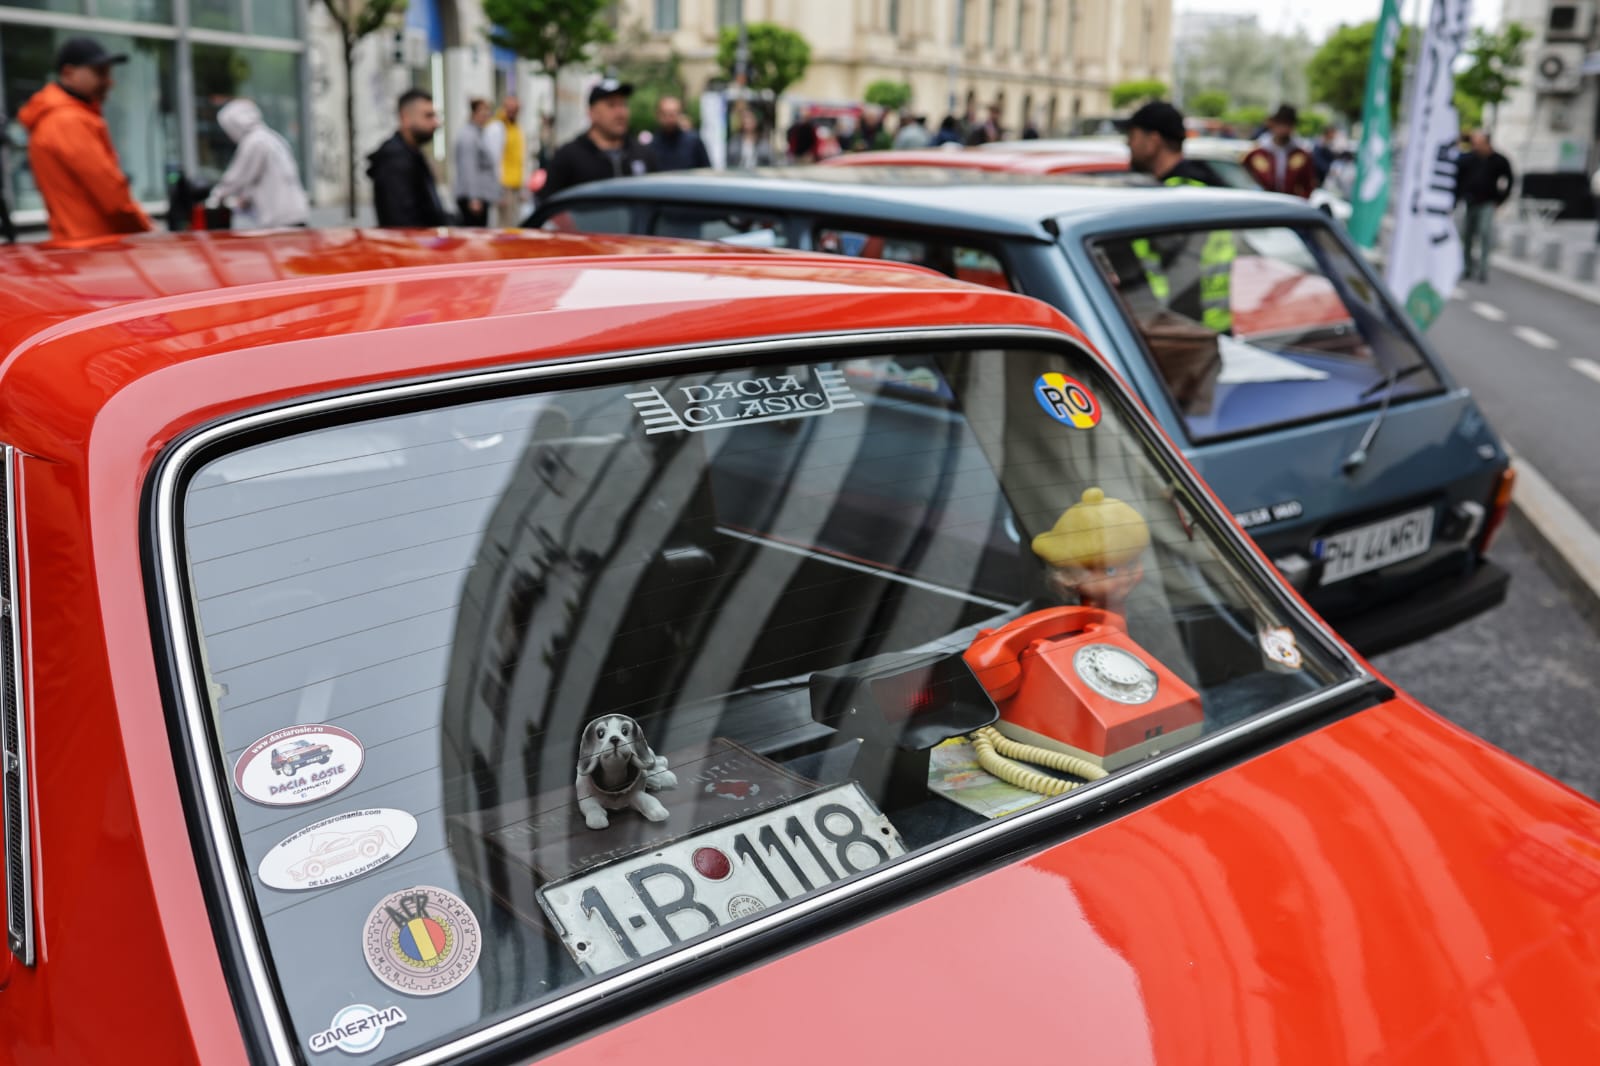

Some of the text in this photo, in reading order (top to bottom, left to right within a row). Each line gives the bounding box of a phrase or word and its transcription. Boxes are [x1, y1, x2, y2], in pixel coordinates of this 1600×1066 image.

[680, 375, 804, 404] DACIA
[1041, 385, 1092, 416] RO
[684, 393, 826, 424] CLASIC
[269, 764, 346, 795] DACIA ROSIE
[281, 810, 382, 847] www.retrocarsromania.com
[330, 874, 344, 883] CAL
[366, 853, 392, 869] PUTERE
[733, 803, 890, 902] 1118
[384, 895, 431, 929] ACR
[372, 919, 416, 985] AUTOMOBIL
[431, 946, 471, 985] CLUBUL
[312, 1007, 403, 1048] OMERTHA
